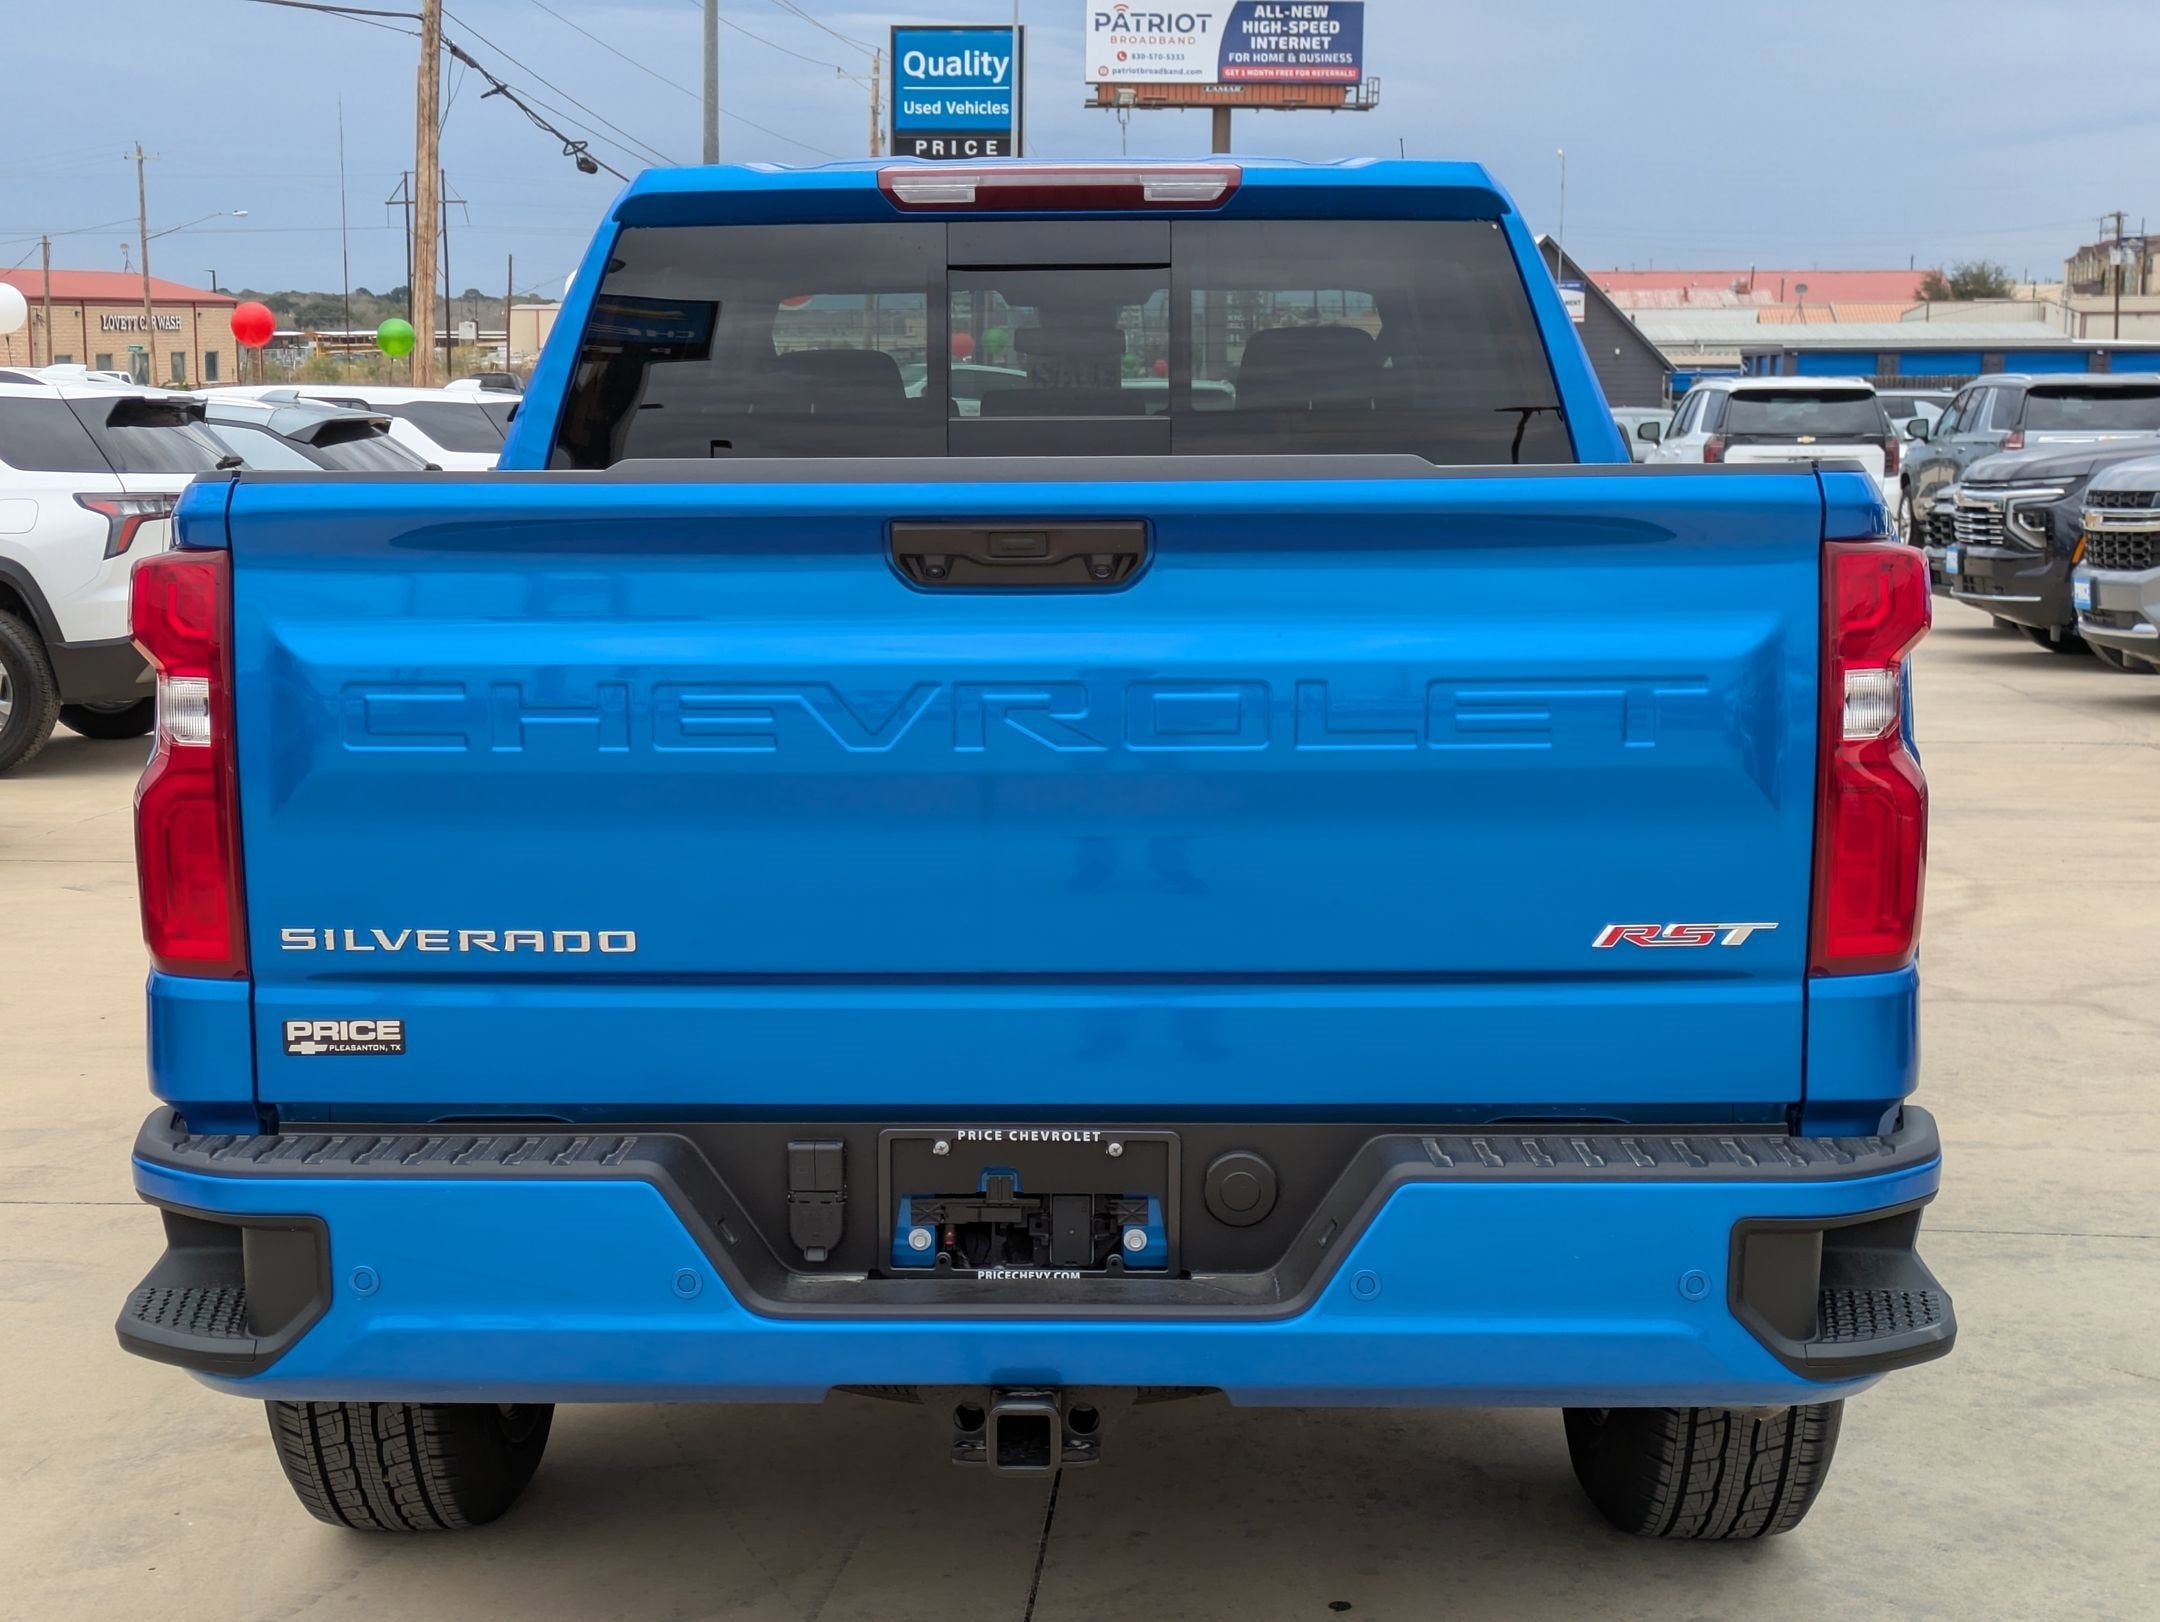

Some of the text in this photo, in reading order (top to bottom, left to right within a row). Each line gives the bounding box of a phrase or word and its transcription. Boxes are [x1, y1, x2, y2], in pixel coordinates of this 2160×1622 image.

[1253, 5, 1328, 18] ALL-NEW
[1095, 12, 1212, 33] PATRIOT
[1242, 20, 1340, 34] HIGH-SPEED
[1110, 35, 1196, 45] BROADBAND
[1250, 36, 1332, 50] INTERNET
[1228, 52, 1353, 63] FOR HOME & BUSINESS
[903, 50, 1010, 84] Quality
[1112, 67, 1203, 75] patriotbroadband.com
[1247, 69, 1274, 77] MONTH
[1276, 69, 1294, 77] FREE
[1295, 69, 1310, 77] FOR
[903, 101, 1010, 115] Used Vehicles
[915, 140, 998, 155] PRICE
[101, 315, 182, 330] LOVETT CR WASH
[341, 676, 1709, 753] CHEVROLET
[280, 928, 637, 953] SILVERADO
[1592, 922, 1779, 948] RST
[287, 1020, 401, 1041] PRICE
[329, 1044, 388, 1052] PLEASANTON,
[957, 1130, 1101, 1142] PRICE CHEVROLET
